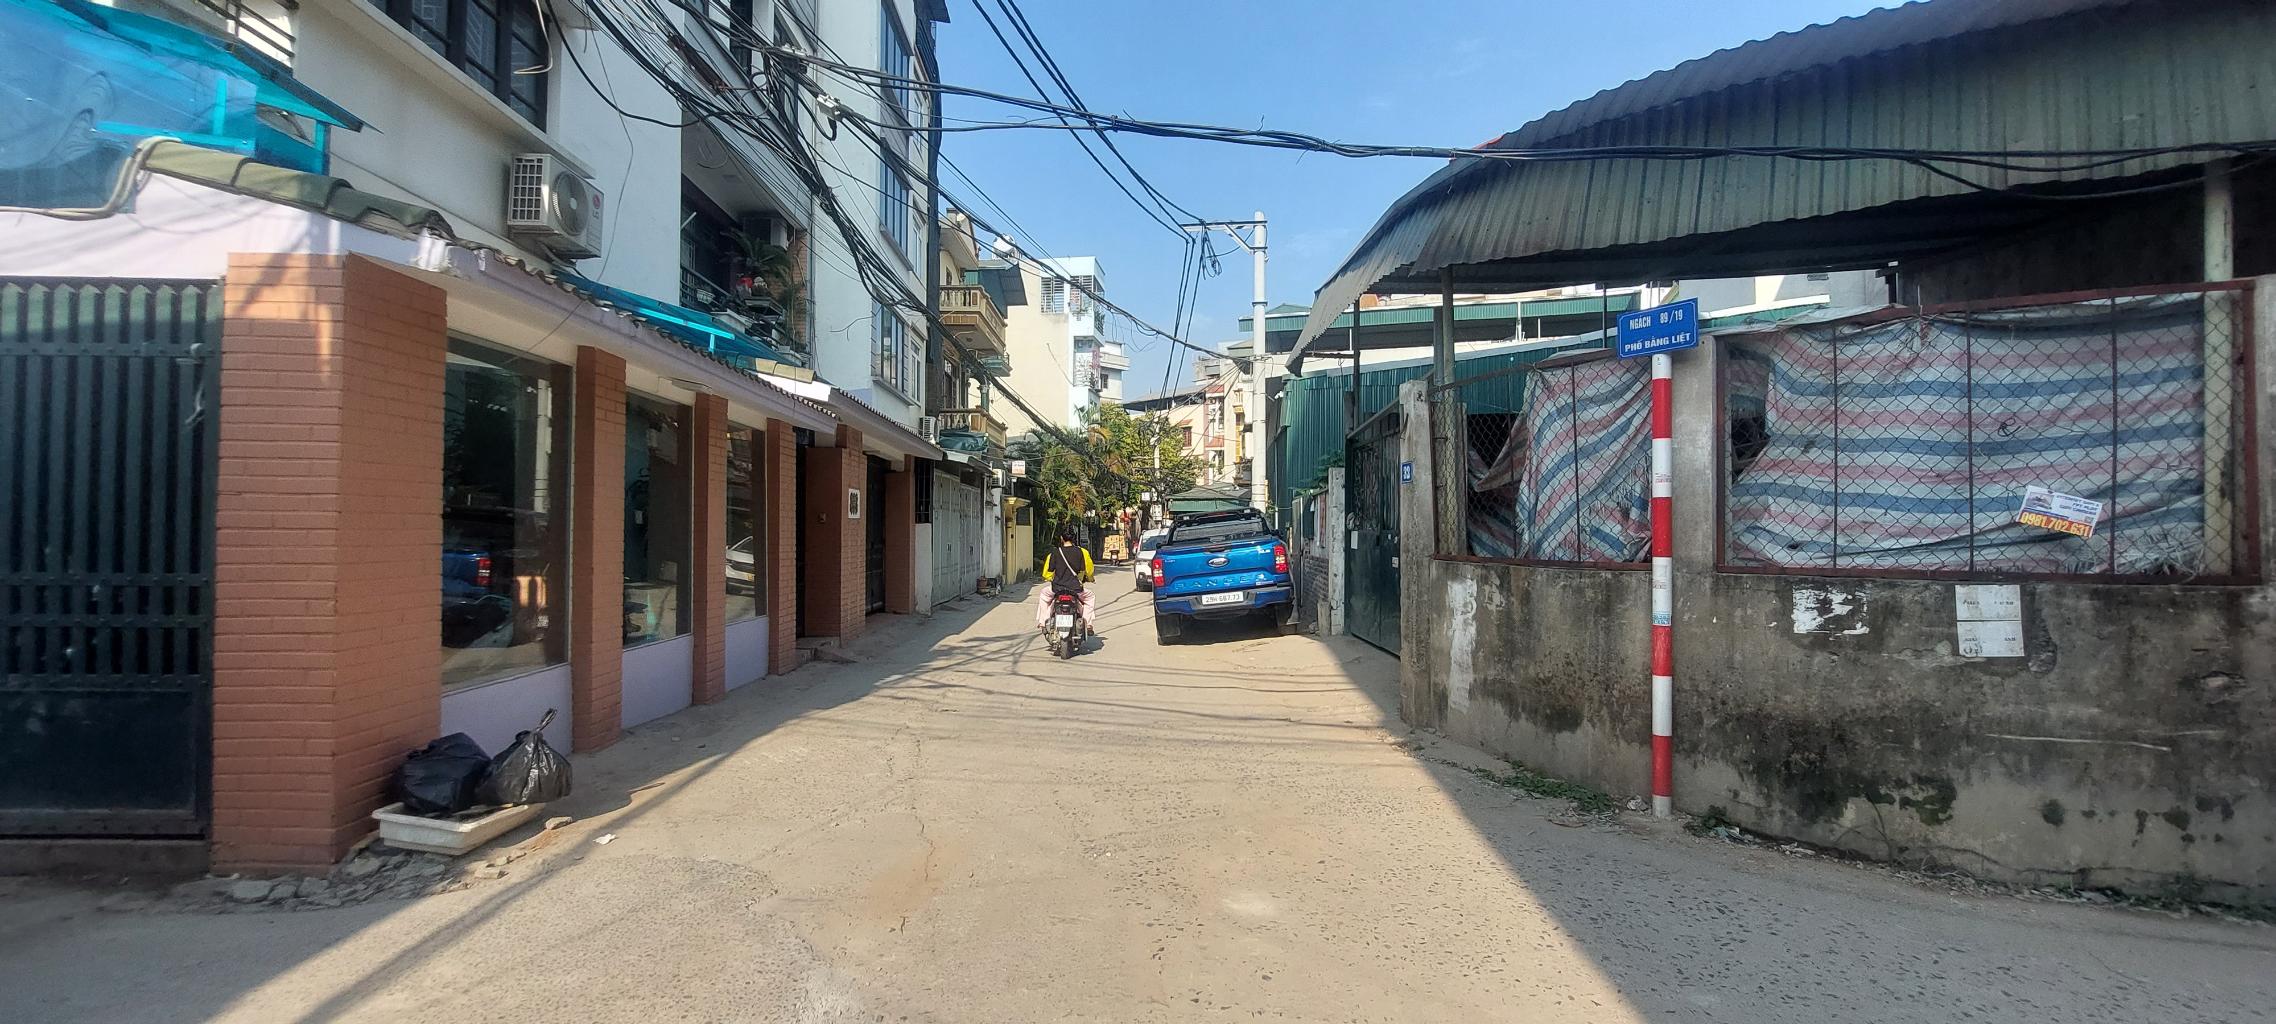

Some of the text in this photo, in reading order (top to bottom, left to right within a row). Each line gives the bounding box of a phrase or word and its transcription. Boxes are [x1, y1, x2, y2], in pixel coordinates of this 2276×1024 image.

[1625, 332, 1691, 352] PHỐ BẰNG LIỆT
